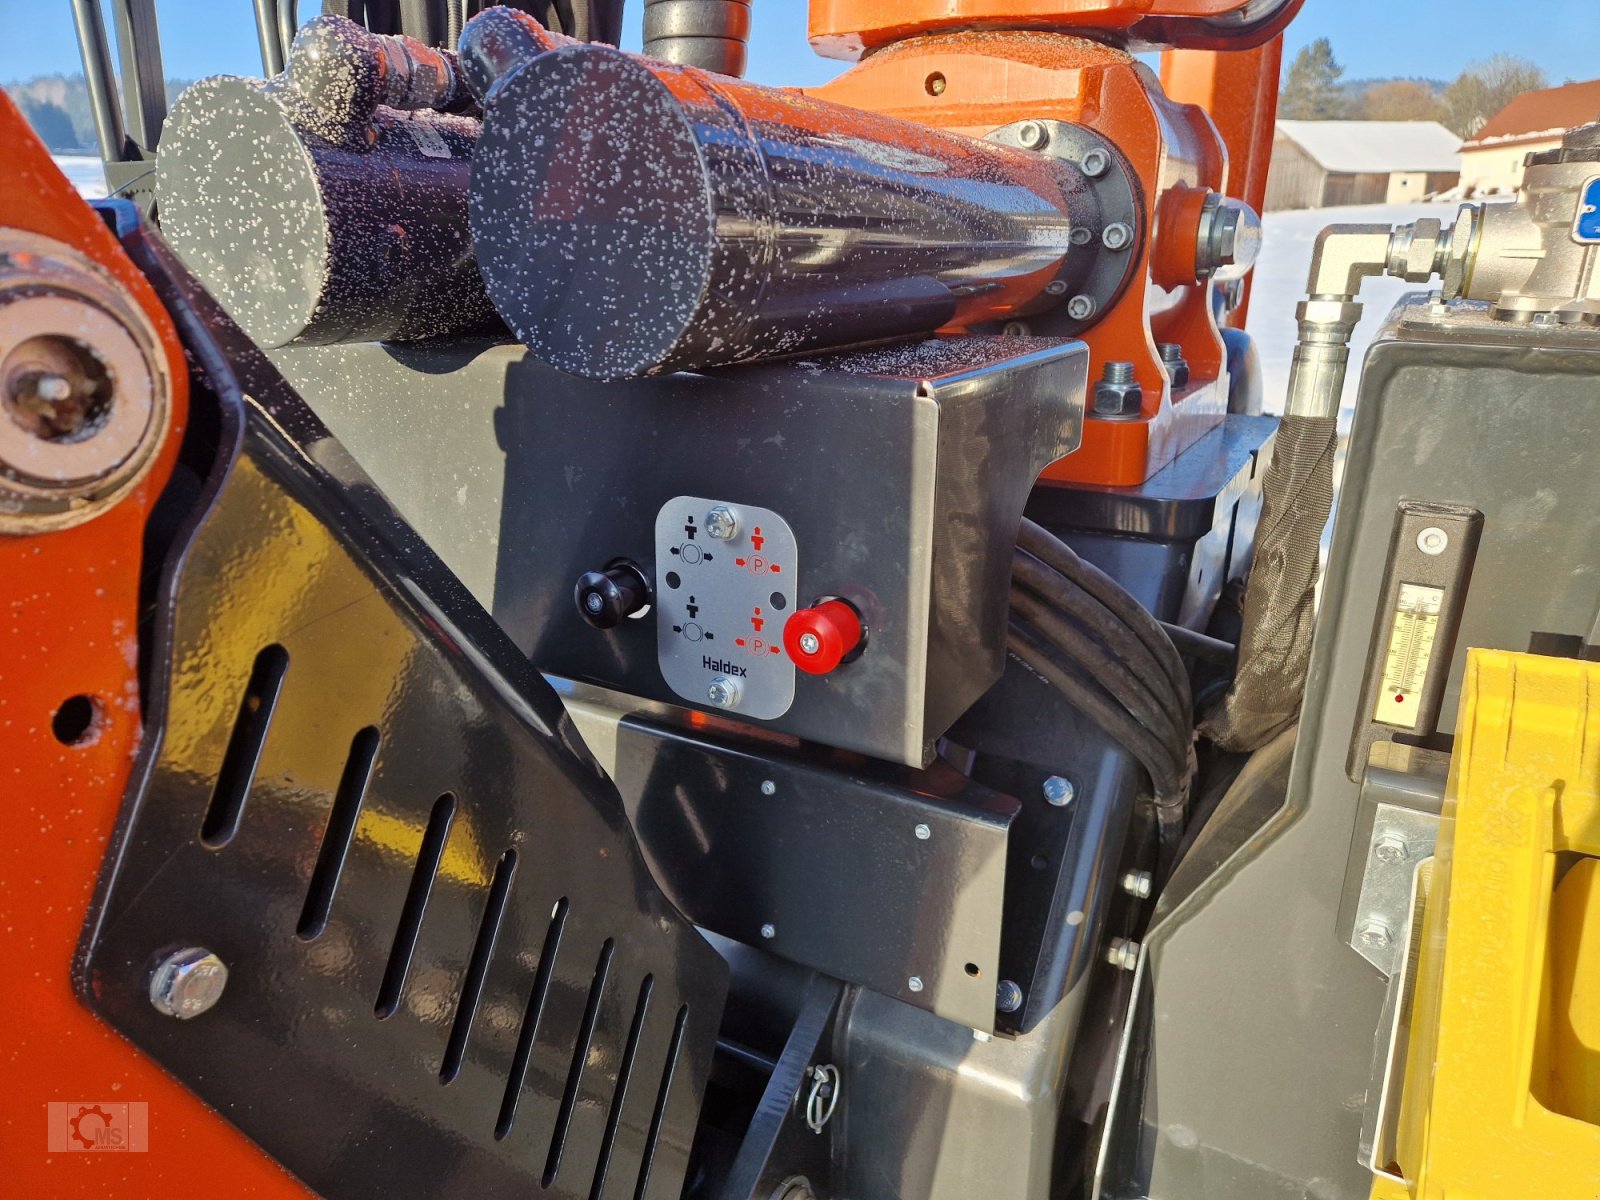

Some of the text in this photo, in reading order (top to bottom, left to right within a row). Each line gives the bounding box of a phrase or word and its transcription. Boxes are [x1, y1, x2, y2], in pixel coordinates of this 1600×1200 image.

[755, 559, 763, 571] P
[755, 639, 763, 651] P
[702, 655, 747, 678] Haldex
